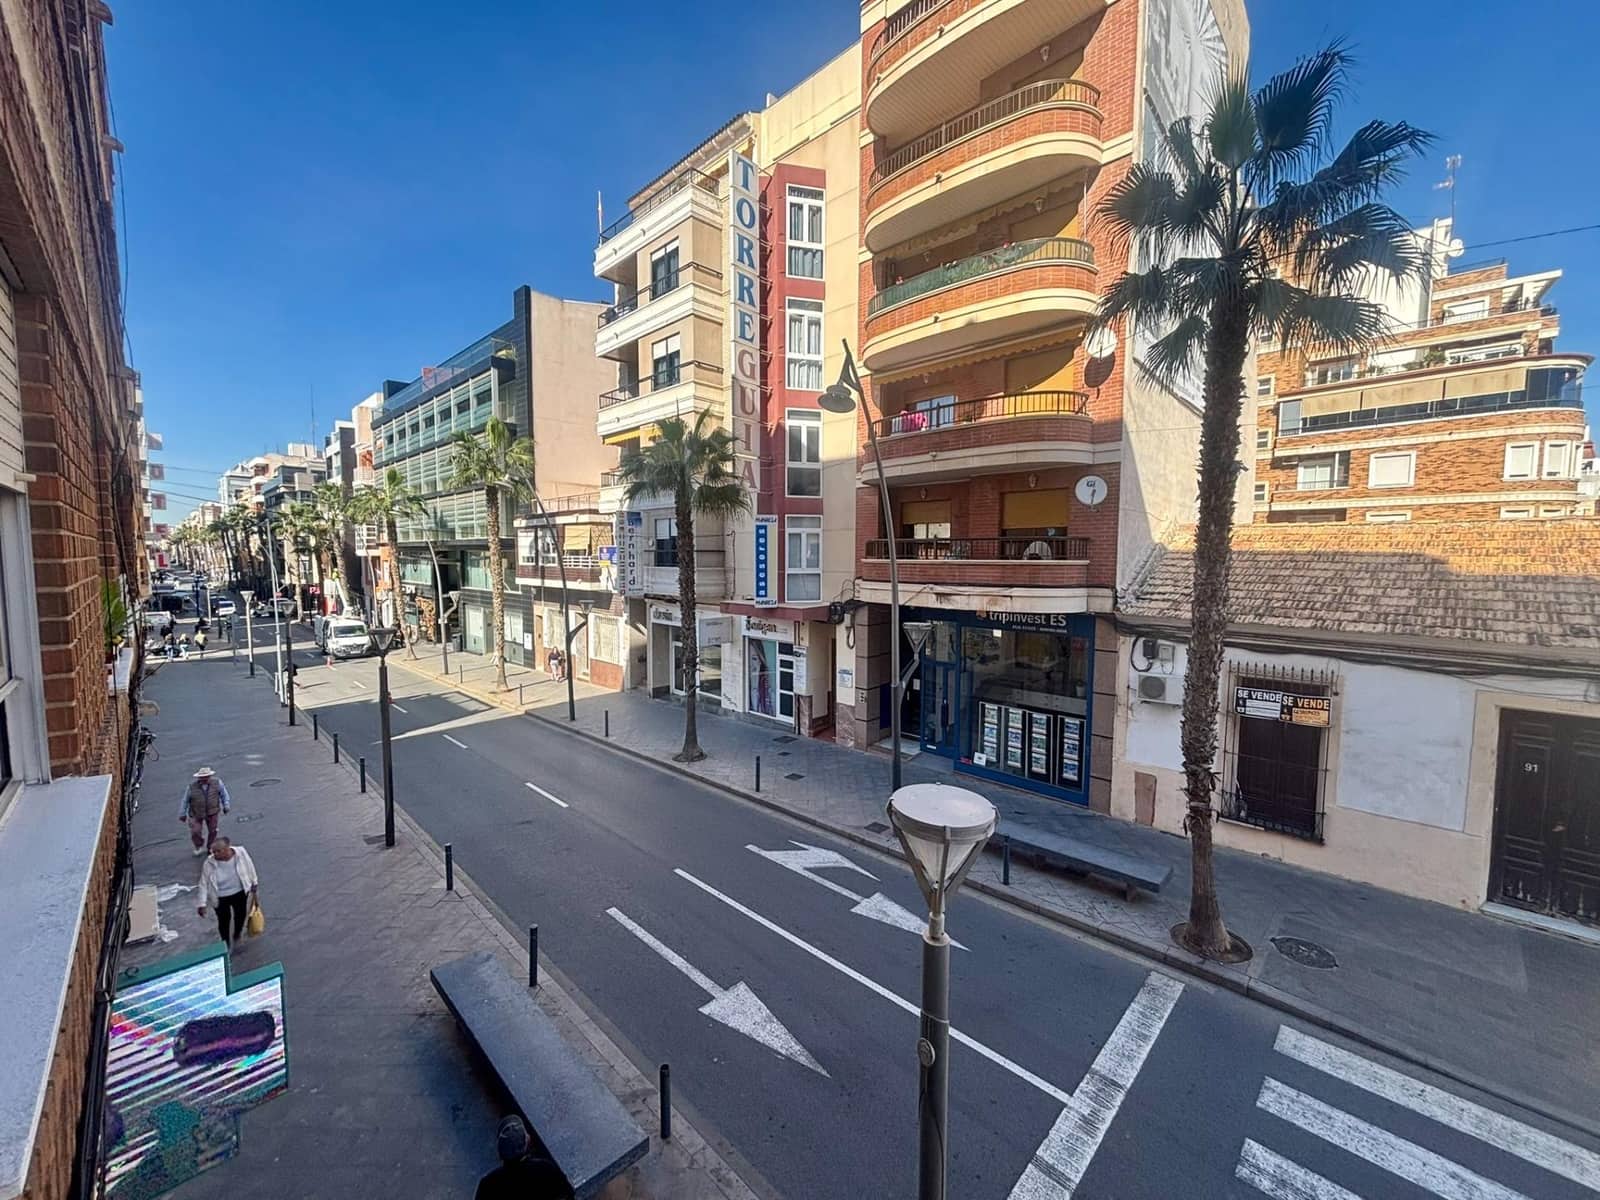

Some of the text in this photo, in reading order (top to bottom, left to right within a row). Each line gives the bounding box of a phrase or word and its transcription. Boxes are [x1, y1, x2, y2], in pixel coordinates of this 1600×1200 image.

[989, 611, 1067, 626] tripinvest ES
[1237, 689, 1281, 702] SE VENDE
[1282, 696, 1330, 709] SE VENDE
[1525, 762, 1538, 773] 91
